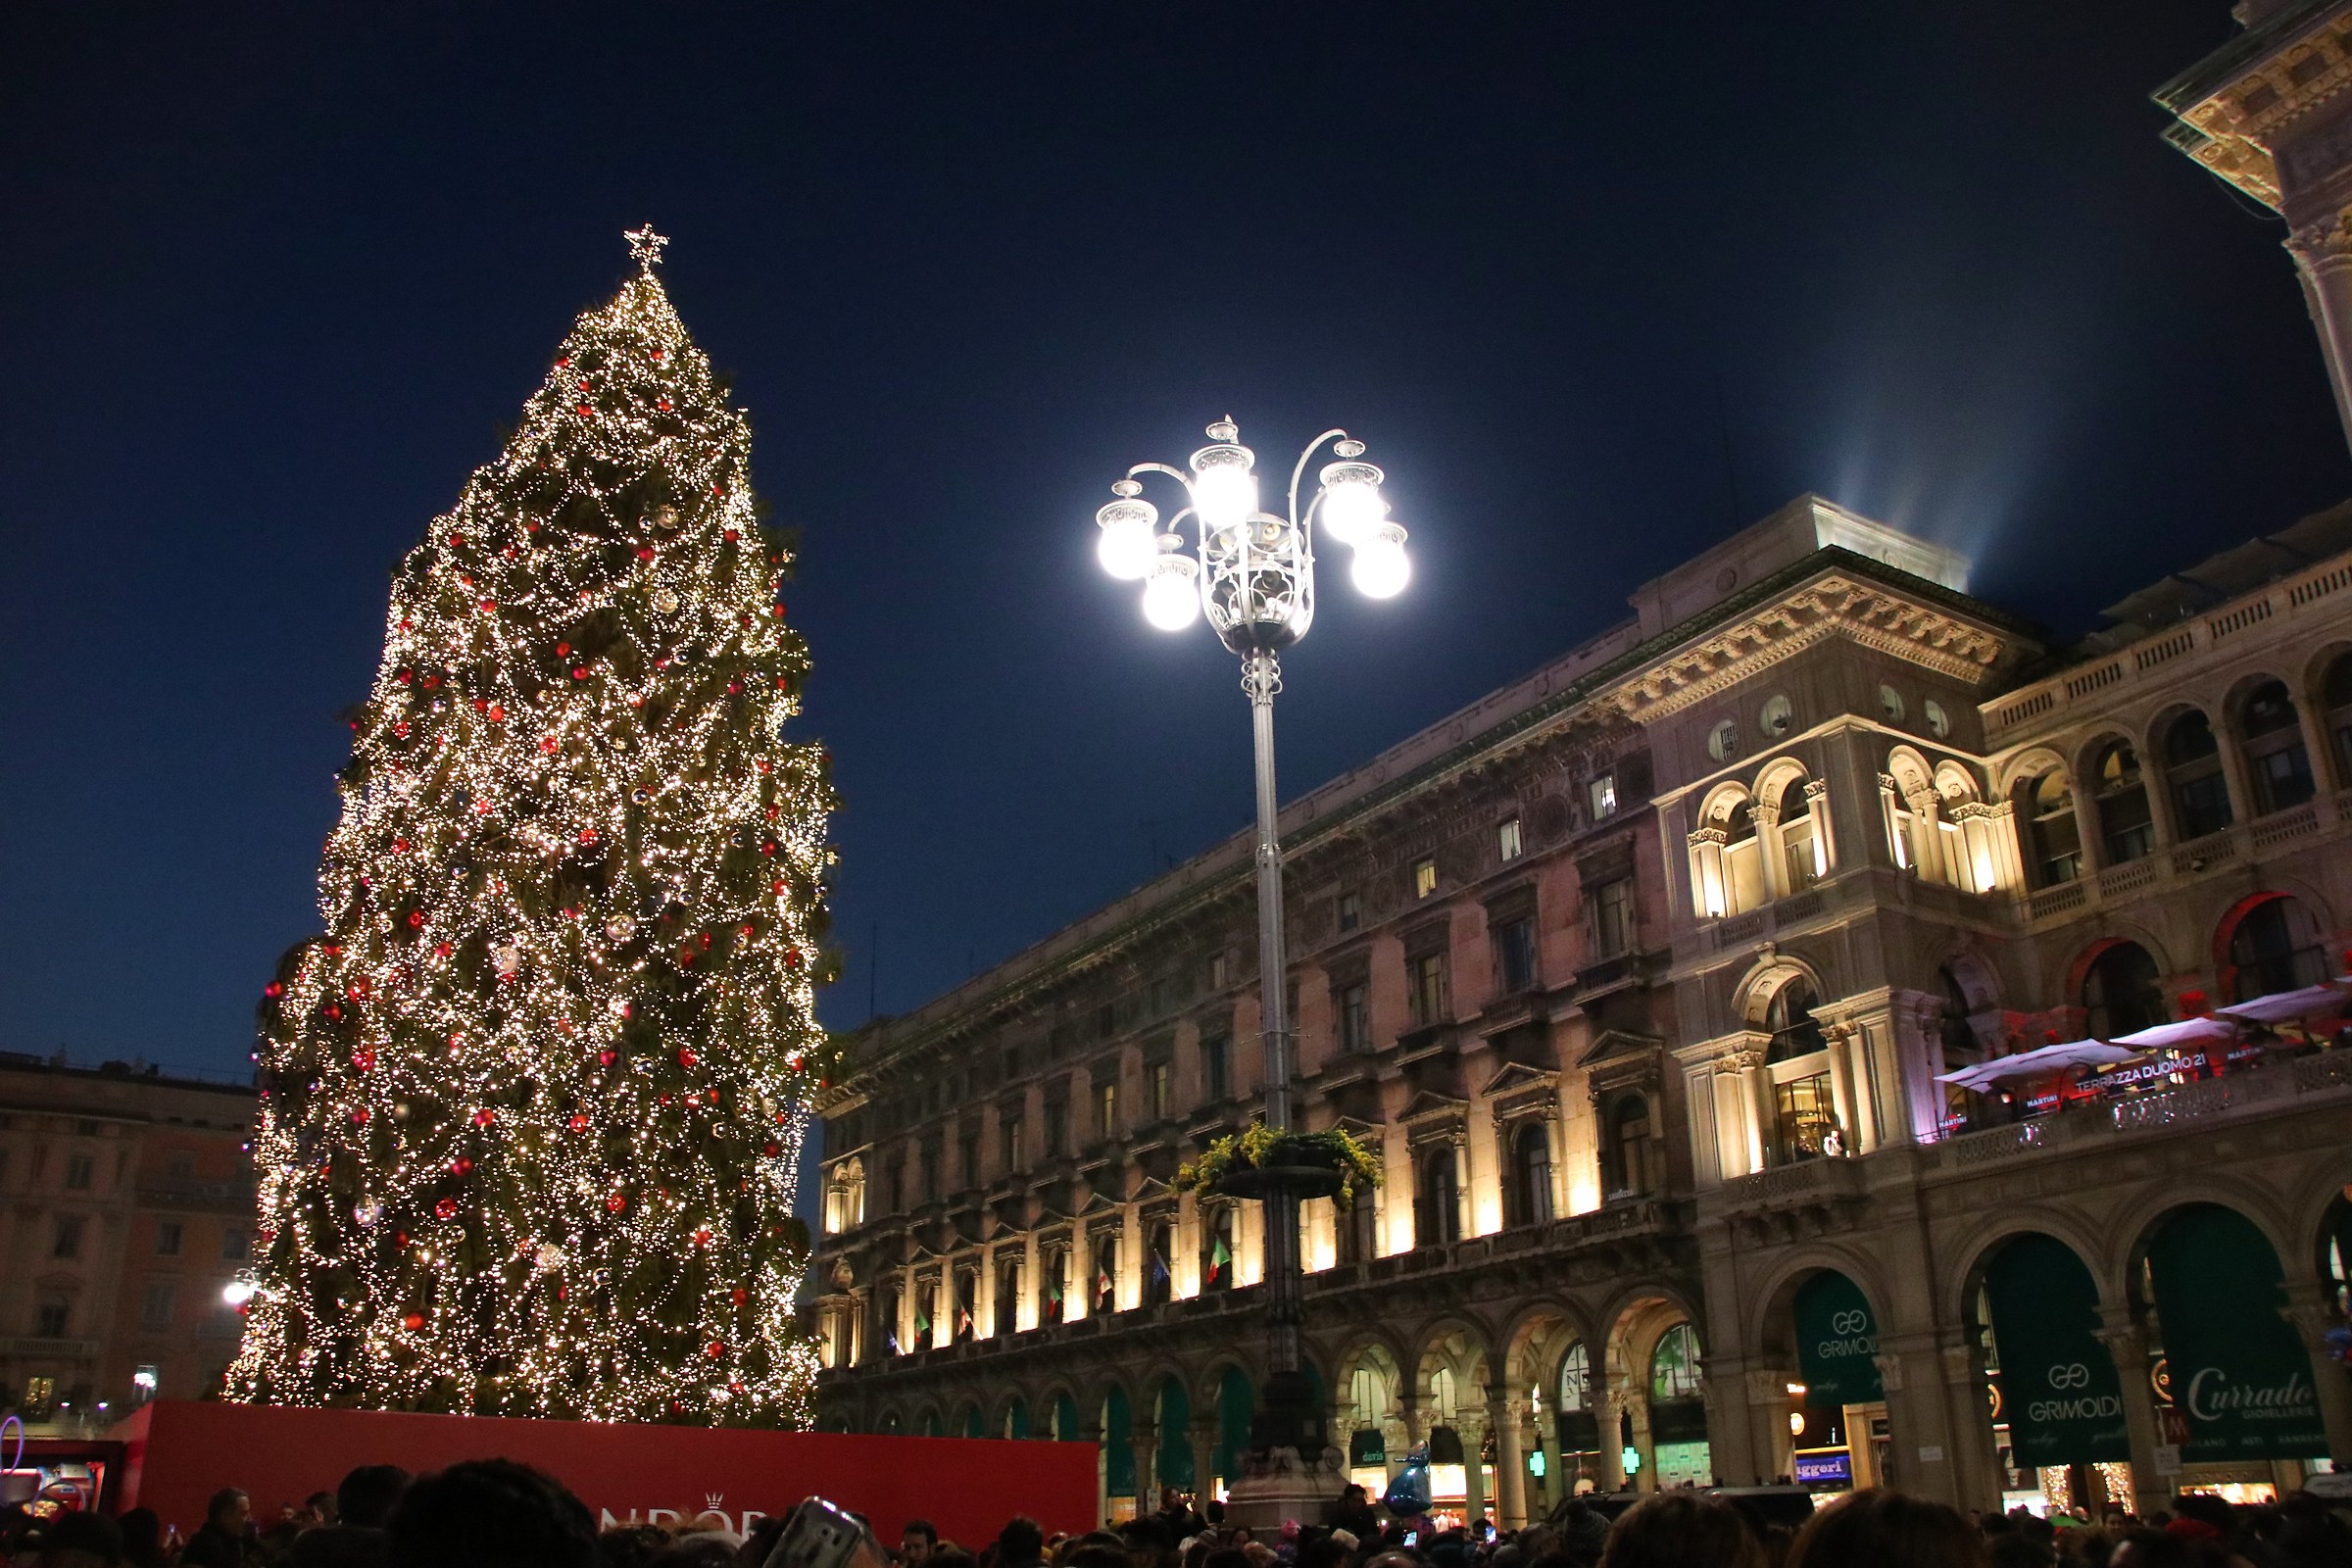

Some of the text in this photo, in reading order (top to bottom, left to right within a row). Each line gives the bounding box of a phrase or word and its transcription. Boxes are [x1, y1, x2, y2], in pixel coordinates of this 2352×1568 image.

[2076, 1053, 2207, 1094] TERRAZZA DUOMO 21
[2027, 1095, 2058, 1108] MARTINI
[1938, 1116, 1968, 1128] MARTINI
[2187, 1367, 2314, 1422] Currado
[2029, 1396, 2122, 1423] GRIMOLDI
[2241, 1407, 2316, 1420] GIOIELLERIE
[2167, 1415, 2188, 1437] M
[2240, 1435, 2264, 1446] ASTI
